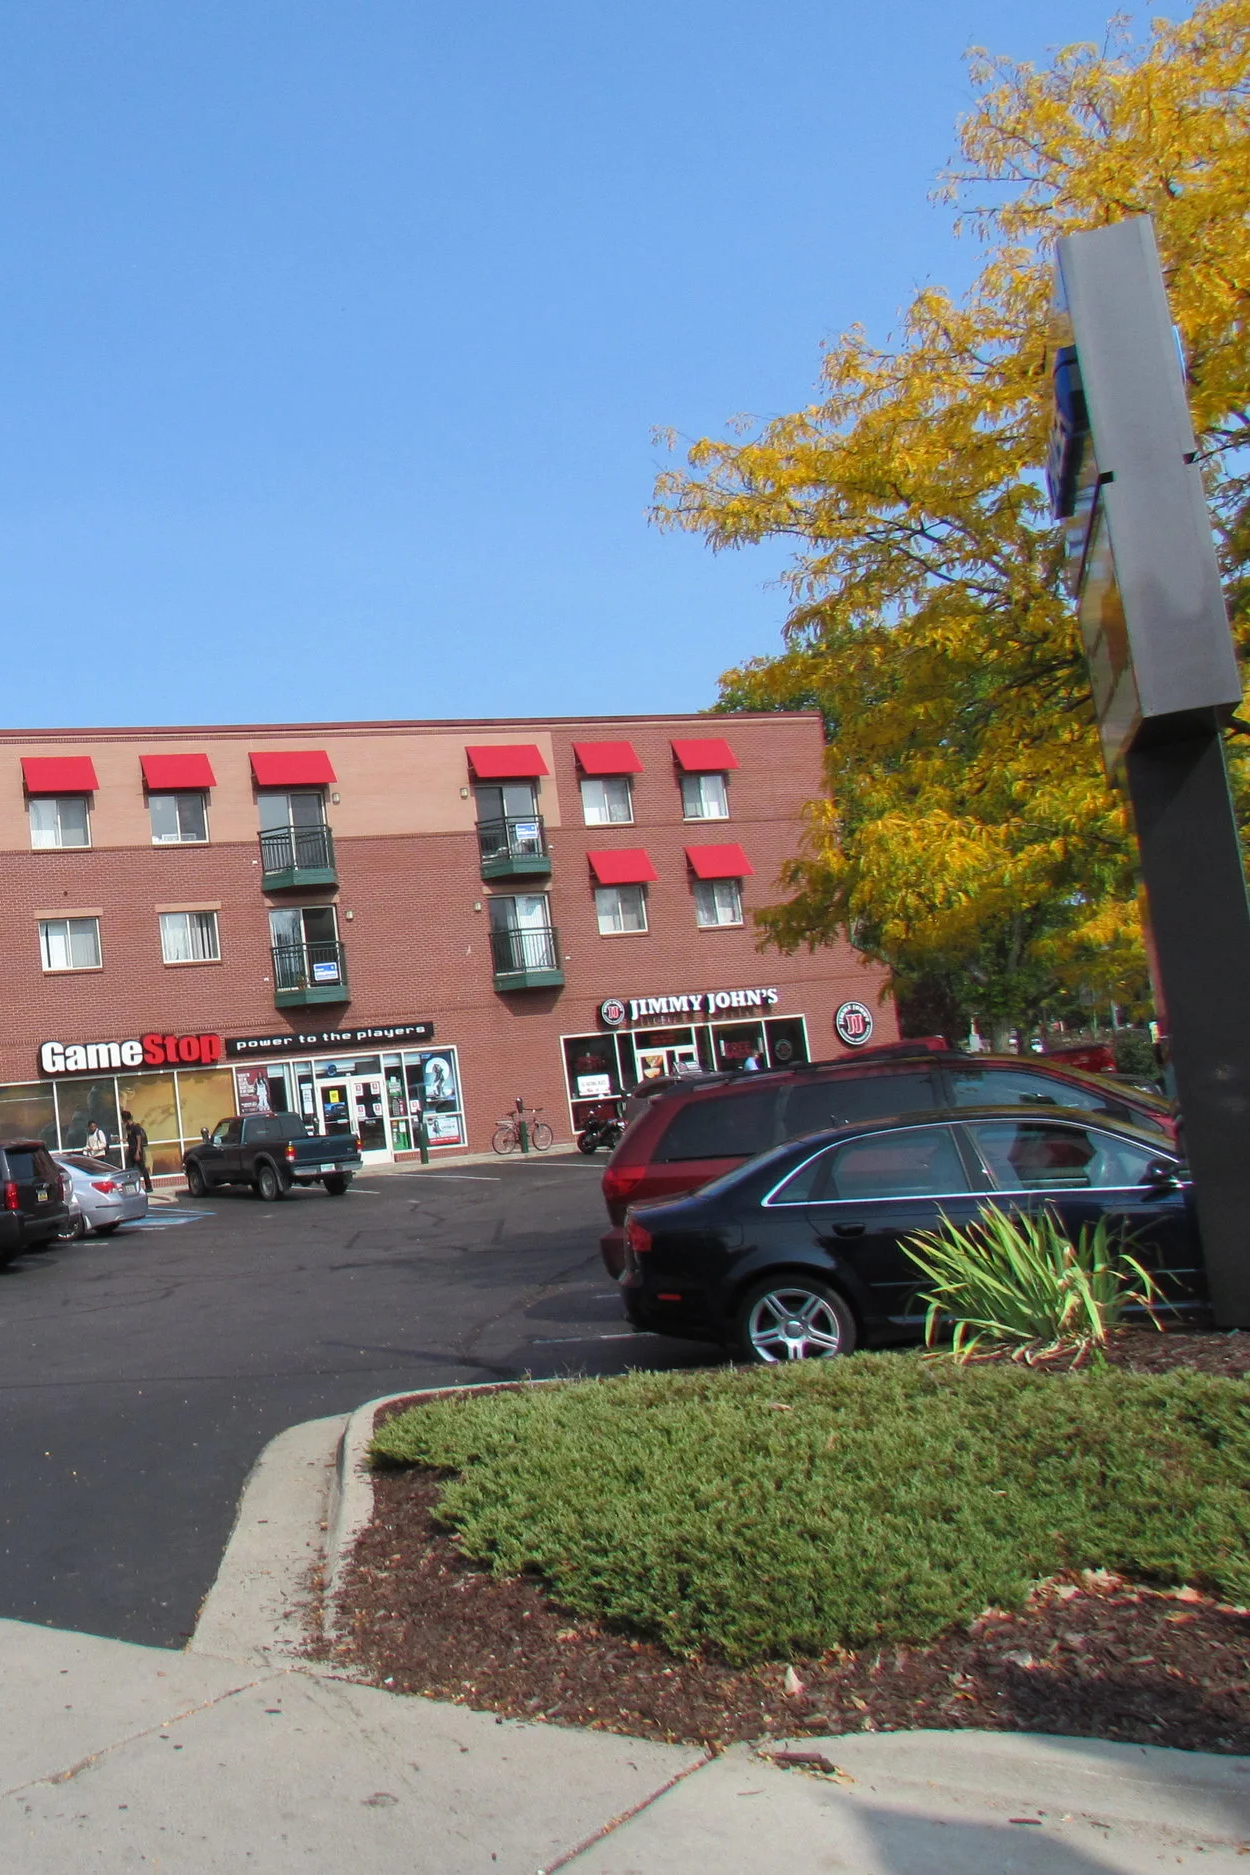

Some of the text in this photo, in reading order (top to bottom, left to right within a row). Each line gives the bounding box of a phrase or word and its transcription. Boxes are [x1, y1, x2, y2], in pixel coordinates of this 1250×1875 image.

[629, 994, 702, 1020] JIMMY
[708, 988, 778, 1013] JOHN'S
[40, 1033, 222, 1073] GameStop
[236, 1024, 427, 1051] power to the players
